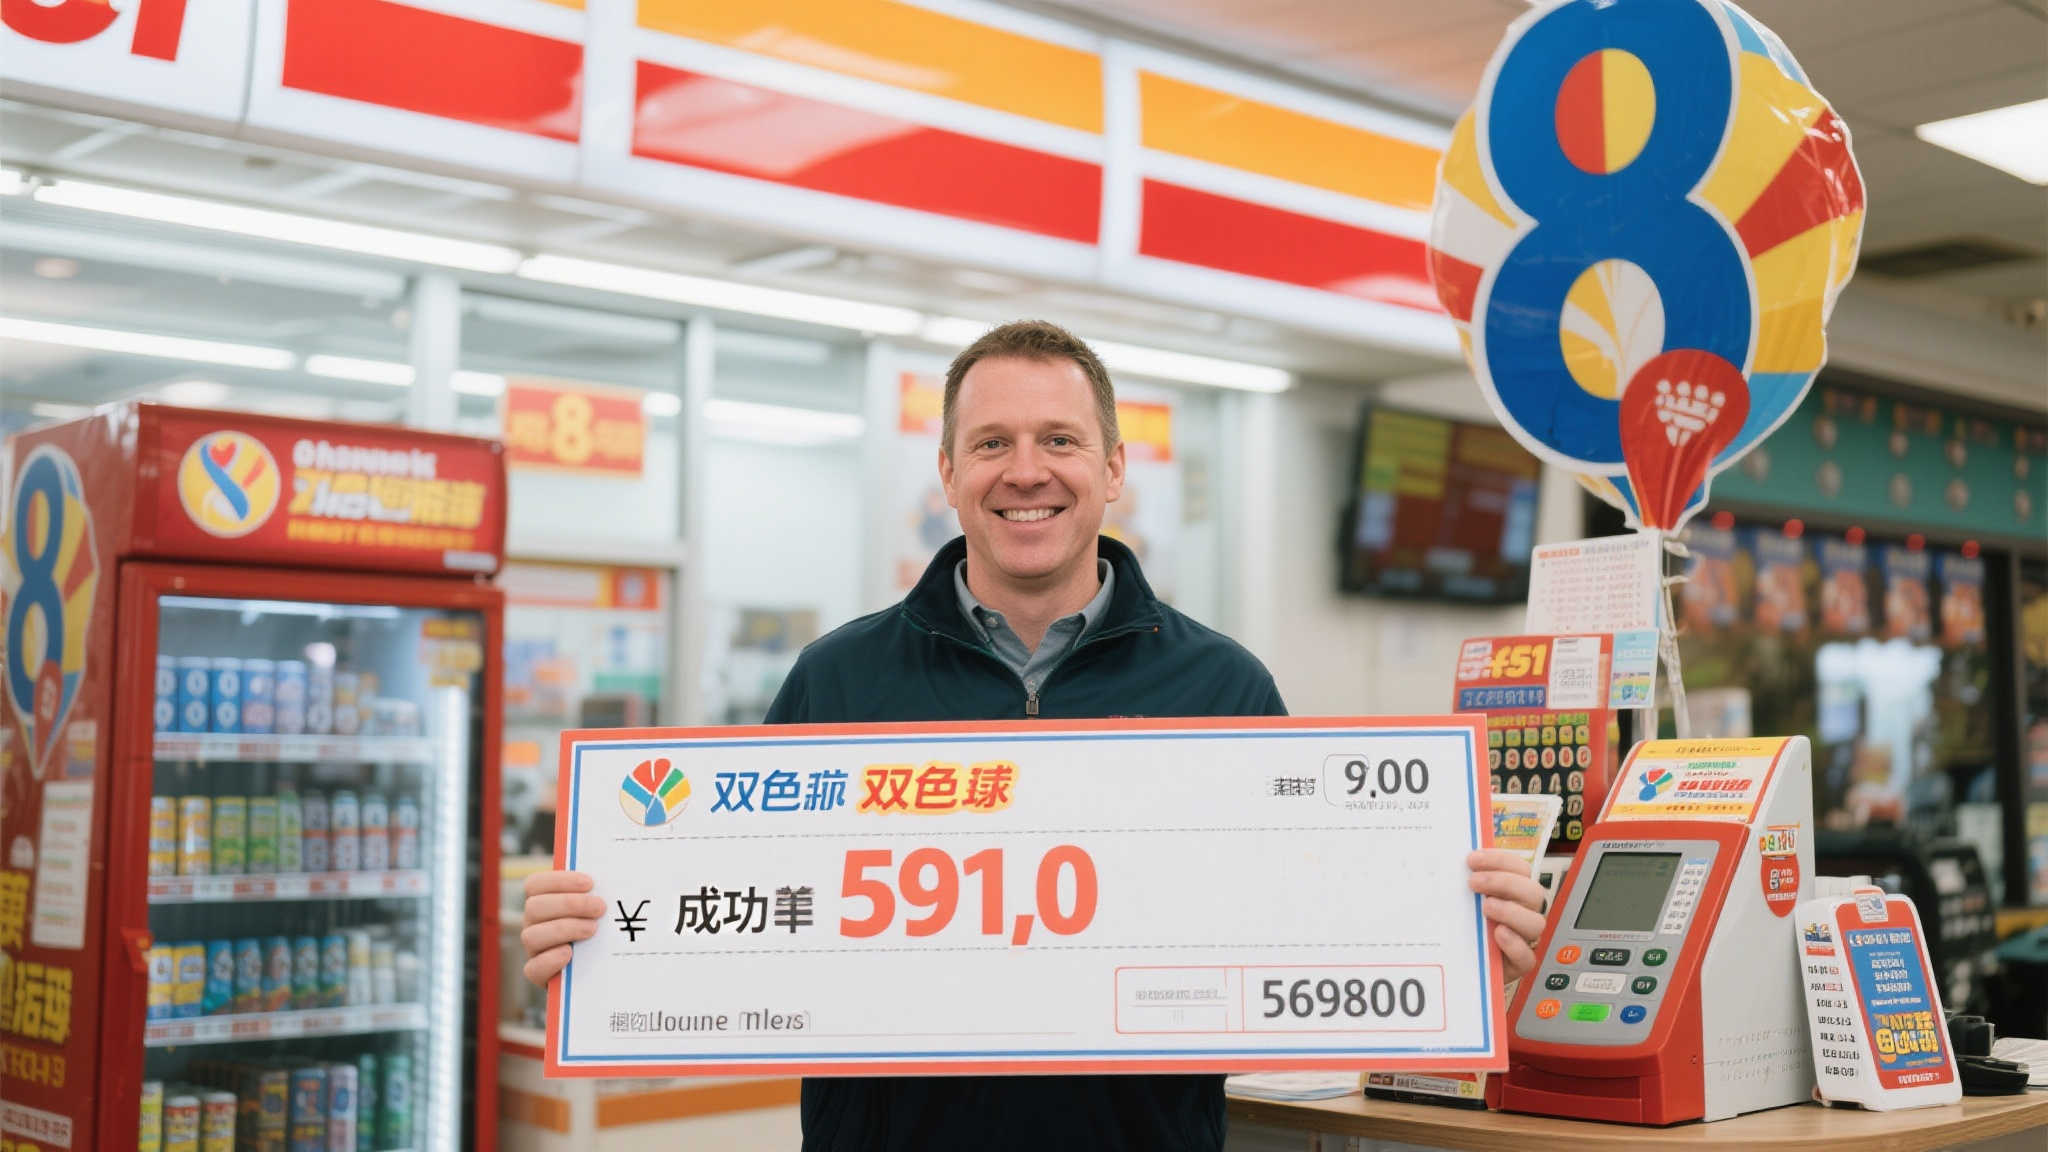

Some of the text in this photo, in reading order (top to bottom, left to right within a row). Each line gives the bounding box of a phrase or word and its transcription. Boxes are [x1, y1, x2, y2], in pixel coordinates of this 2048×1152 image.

[1484, 0, 1752, 465] 8
[553, 394, 593, 462] 8
[861, 766, 1013, 809] 双色球
[839, 845, 1098, 946] 591,0
[1262, 978, 1426, 1018] 569800
